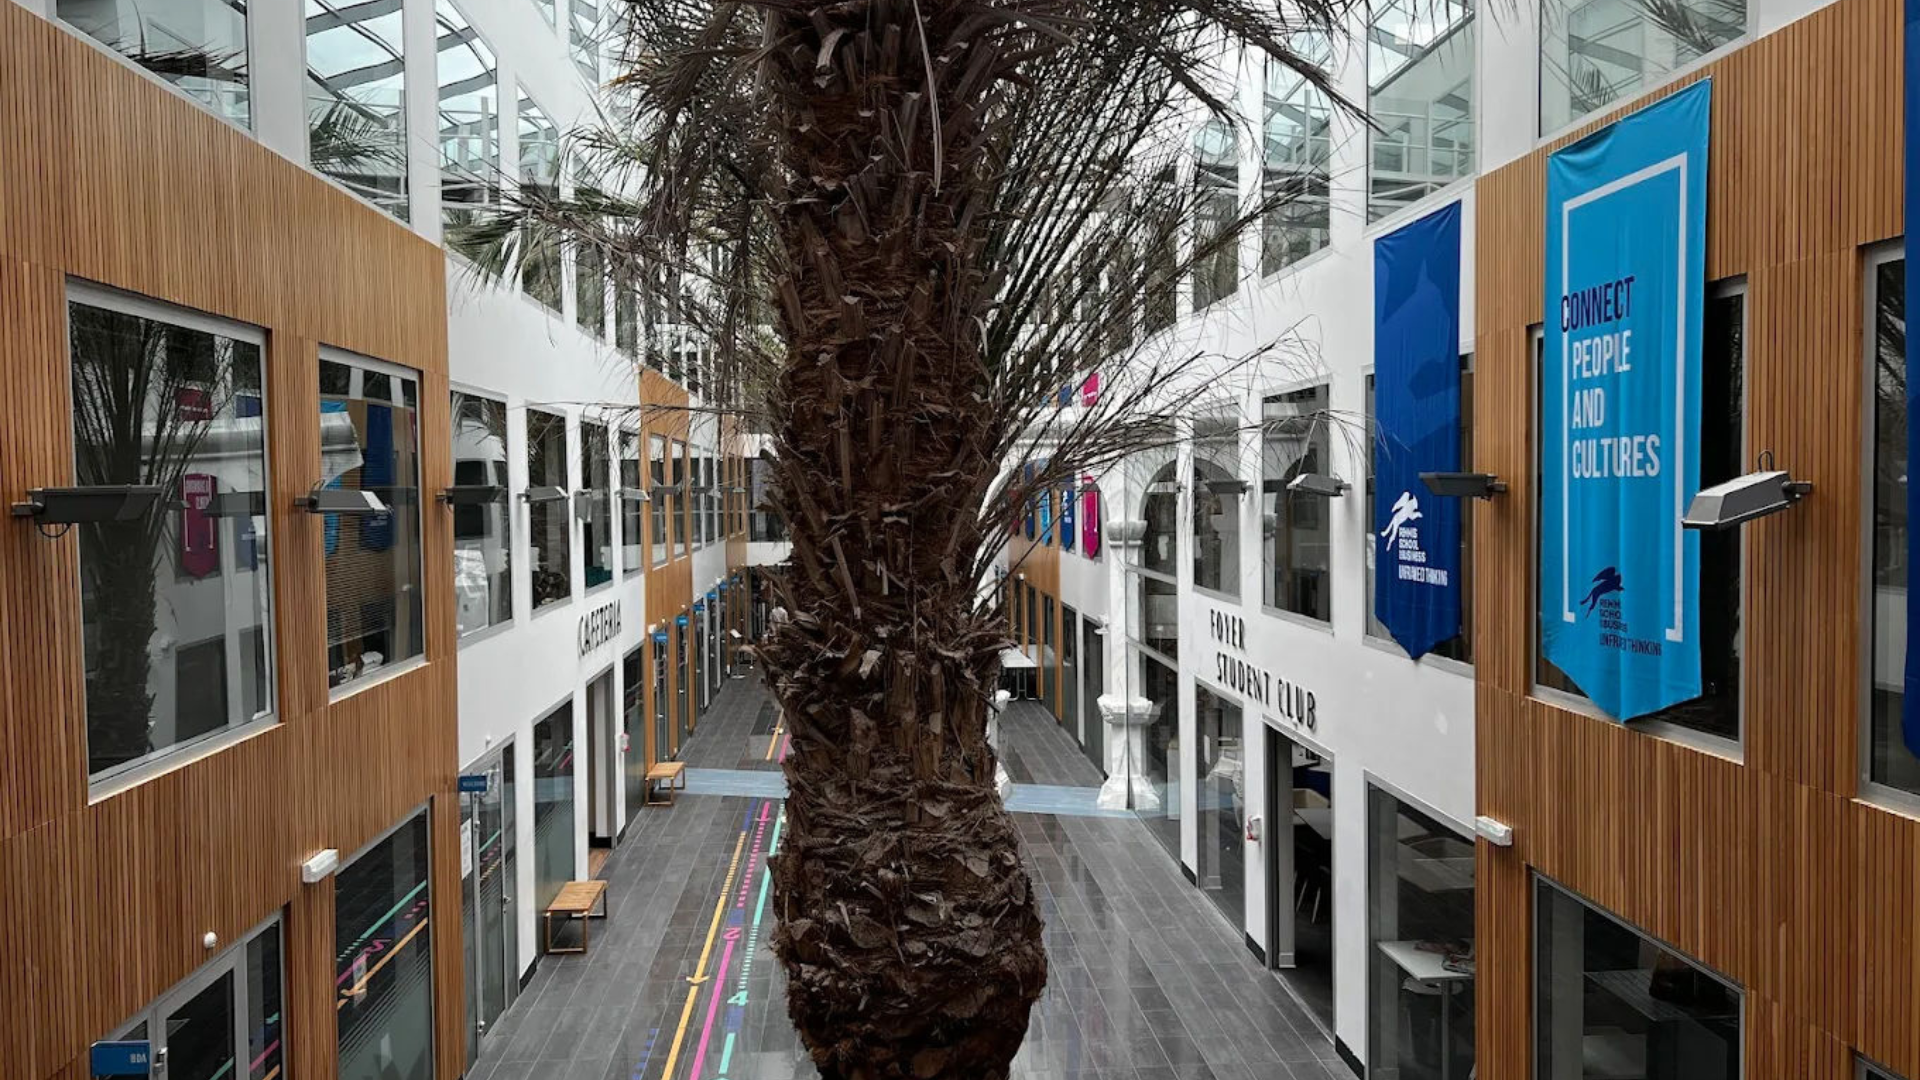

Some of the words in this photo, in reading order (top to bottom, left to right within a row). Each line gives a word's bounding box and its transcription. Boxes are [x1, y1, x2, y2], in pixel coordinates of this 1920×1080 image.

[1561, 276, 1635, 332] CONNECT
[1572, 330, 1632, 379] PEOPLE
[1572, 387, 1605, 429] AND
[1572, 434, 1660, 478] CULTURES
[577, 599, 621, 657] CAFETERIA
[1210, 608, 1246, 650] FOYER
[1217, 652, 1270, 707] STUDENT
[1278, 678, 1317, 731] CLUB
[727, 990, 749, 1006] 4
